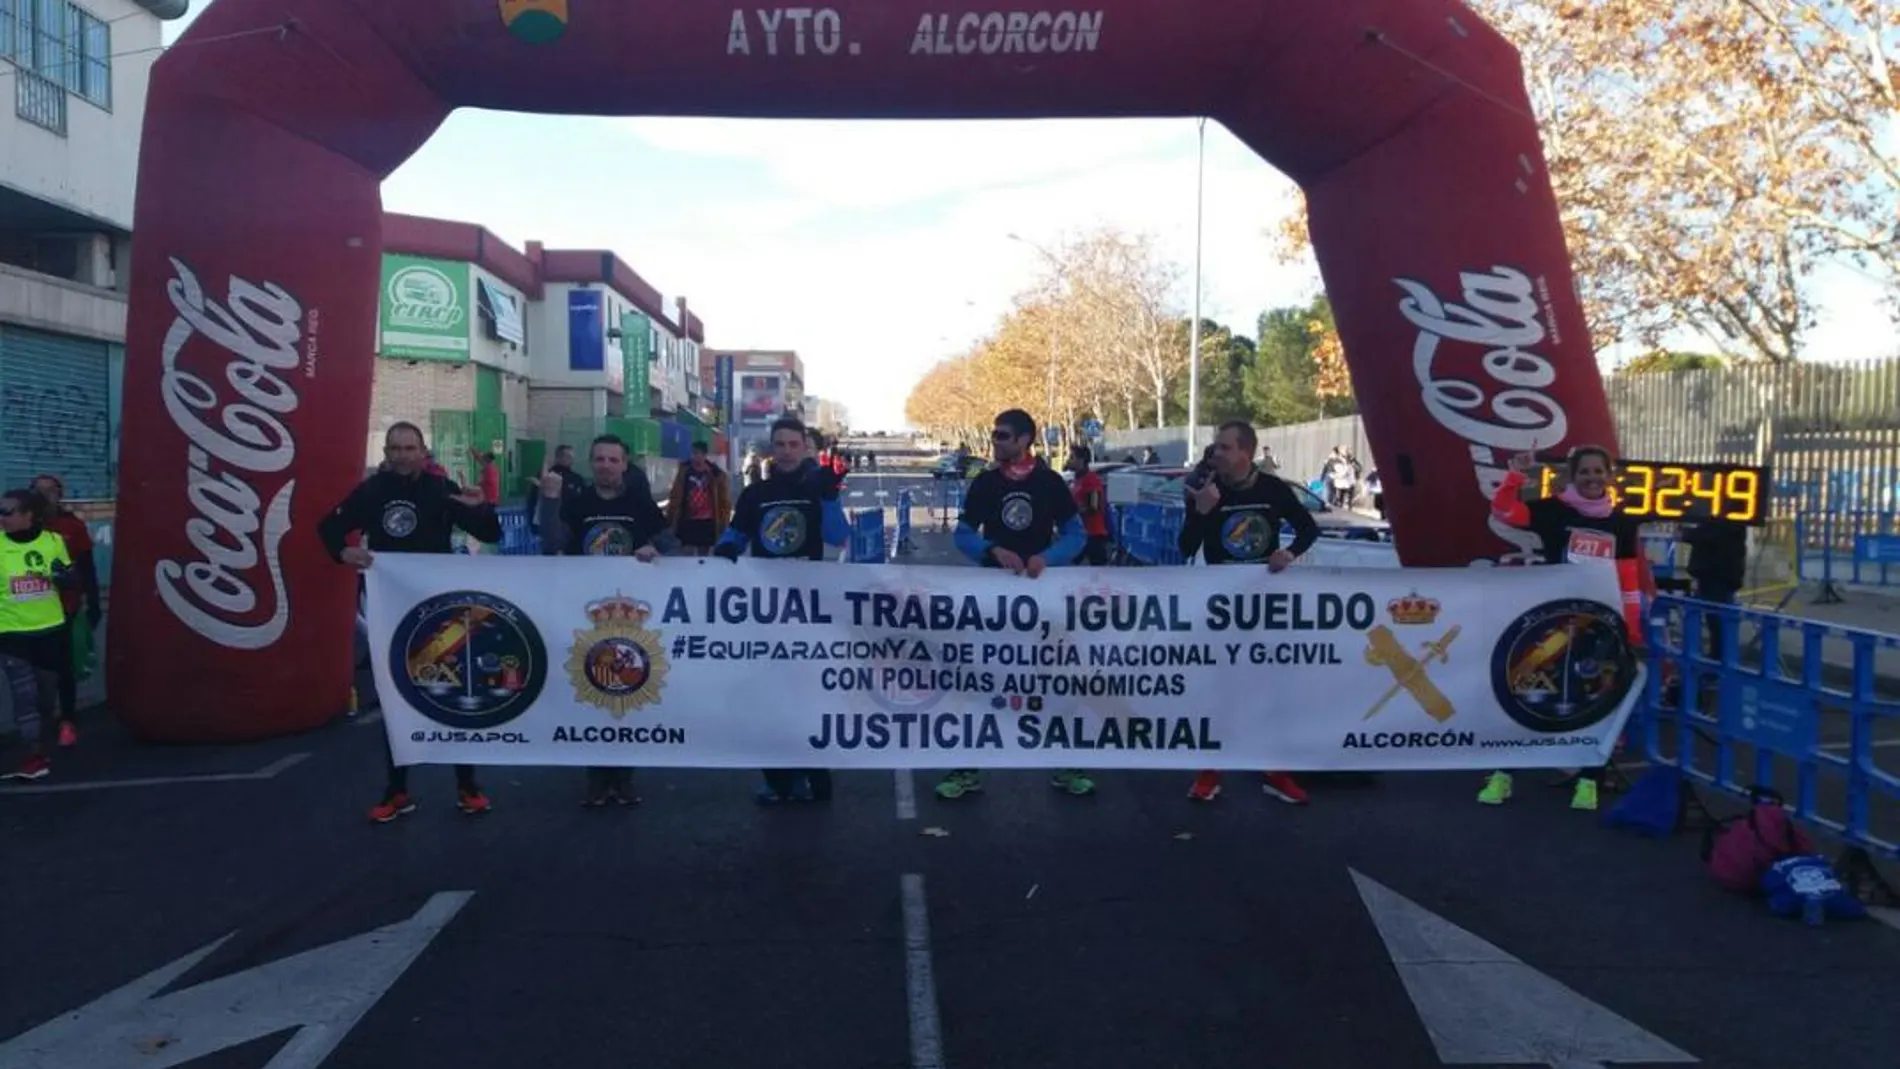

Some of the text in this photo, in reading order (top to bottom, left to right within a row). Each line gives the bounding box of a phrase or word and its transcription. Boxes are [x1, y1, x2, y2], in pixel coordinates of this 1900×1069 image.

[727, 8, 1102, 55] AYTO. ALCORCON
[154, 255, 302, 650] Coca-Cola
[661, 586, 1375, 639] A IGUAL TRABAJO, IGUAL SUELDO
[941, 642, 974, 665] DE
[982, 639, 1081, 667] POLICÍA
[1089, 644, 1217, 667] NACIONAL
[1225, 643, 1242, 666] Y
[1249, 643, 1342, 665] G.CIVIL
[821, 664, 1186, 697] CON POLICÍAS AUTONÓMICAS
[411, 730, 530, 744] @JUSAPOL
[552, 724, 685, 744] ALCORCÓN
[808, 713, 1222, 750] JUSTICIA SALARIAL
[1342, 729, 1475, 749] ALCORCÓN
